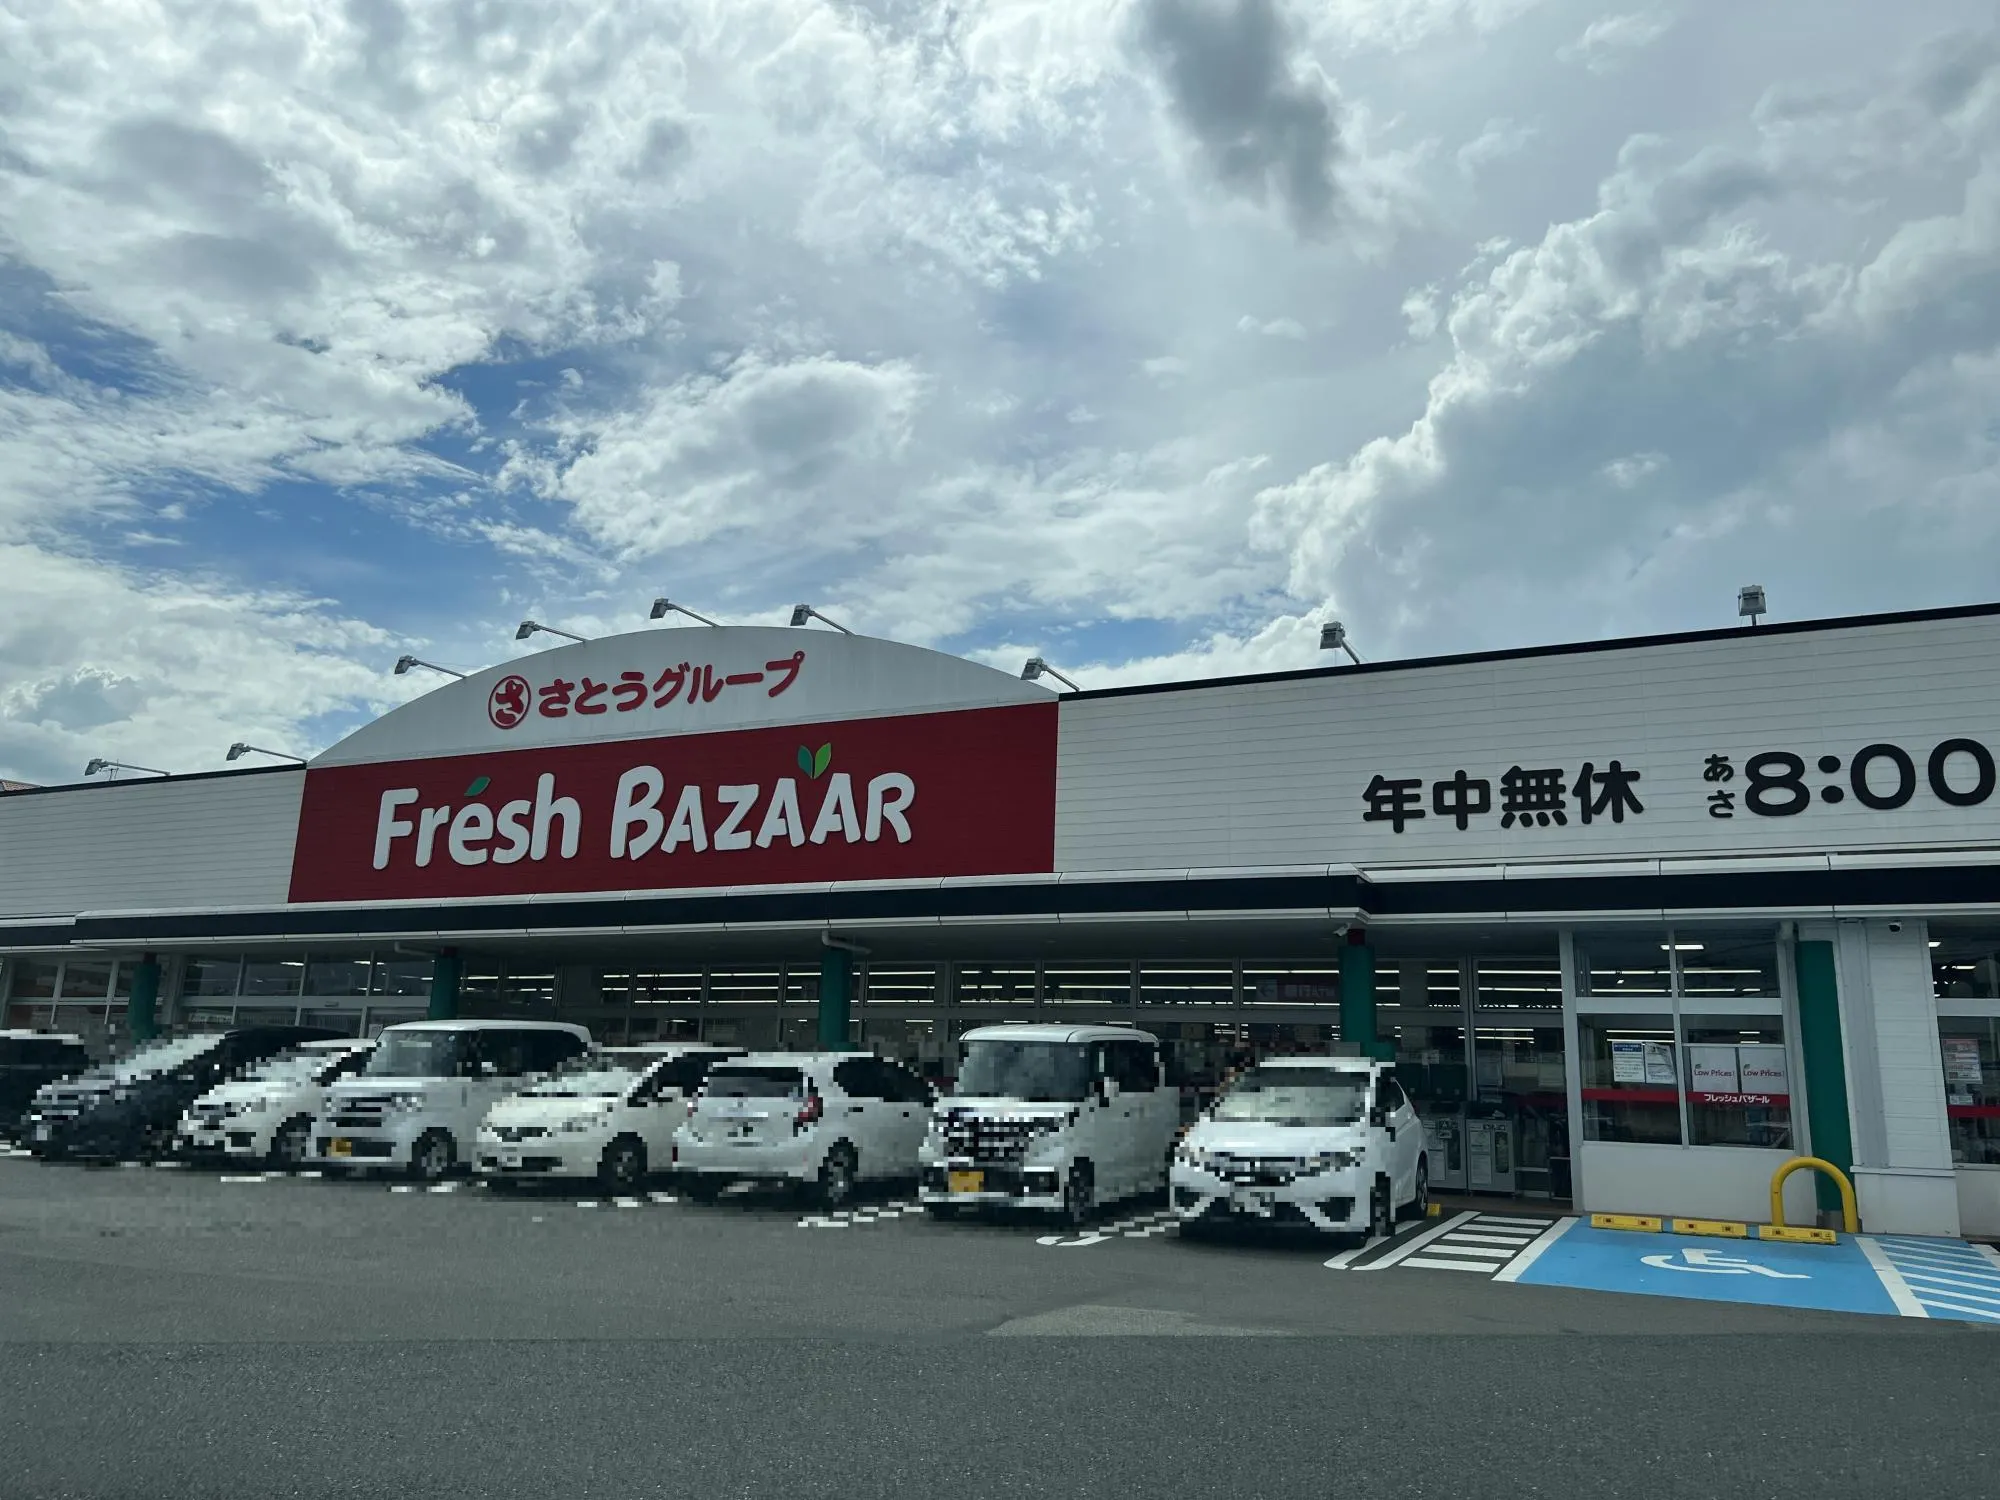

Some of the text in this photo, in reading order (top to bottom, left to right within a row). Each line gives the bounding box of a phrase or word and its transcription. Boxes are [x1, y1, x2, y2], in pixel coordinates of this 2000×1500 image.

[540, 651, 805, 717] さとうグループ
[1361, 761, 1645, 834] 年中無休
[1703, 739, 1997, 819] あさ 8:00
[372, 766, 916, 870] Fresh BAZAAR
[1694, 1069, 1711, 1078] Low
[1743, 1069, 1759, 1078] Low
